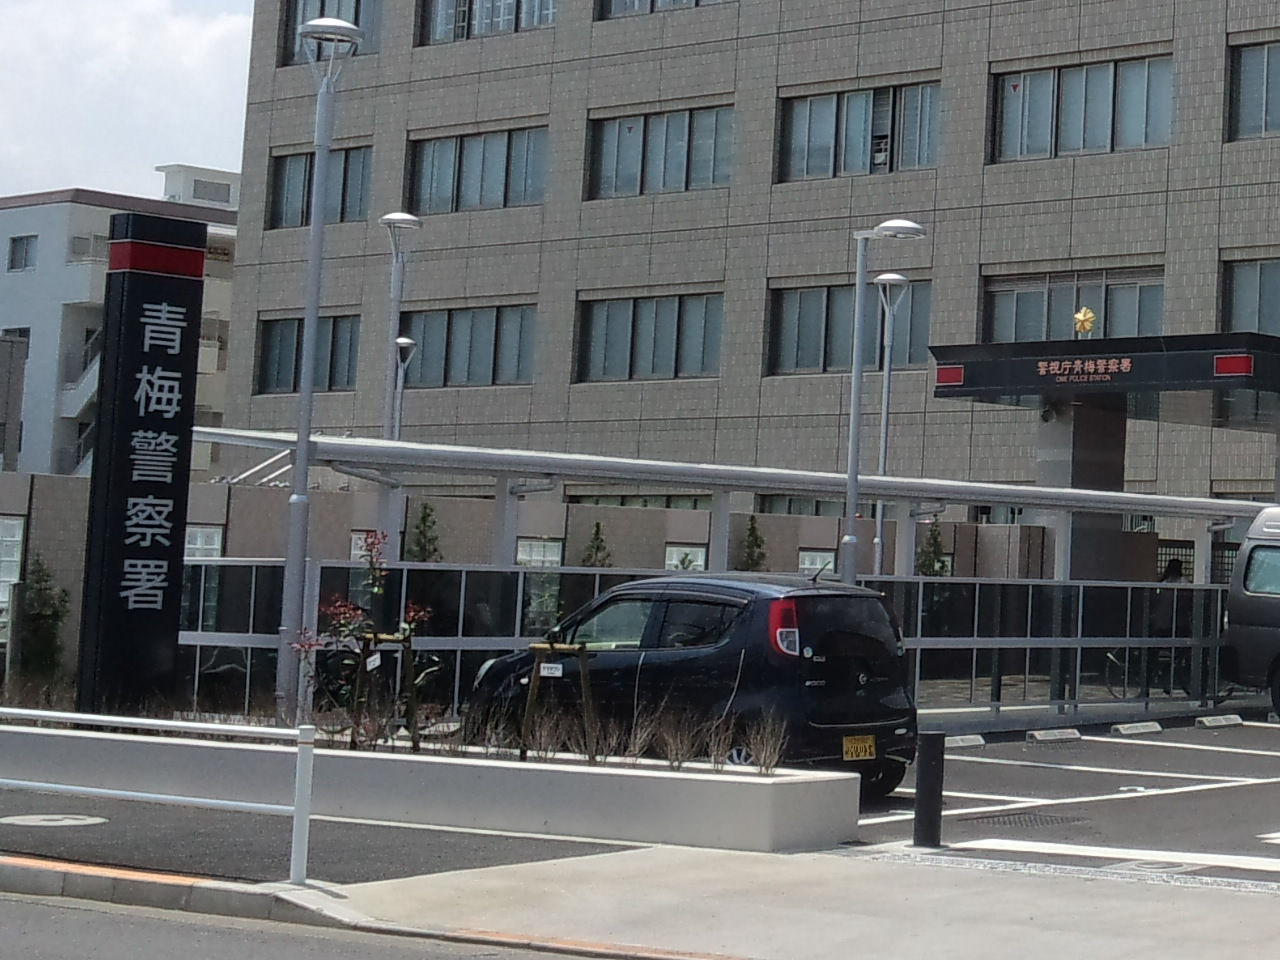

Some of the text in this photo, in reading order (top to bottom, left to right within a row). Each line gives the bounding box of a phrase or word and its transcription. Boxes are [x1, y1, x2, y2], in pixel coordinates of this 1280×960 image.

[1037, 358, 1132, 375] 警視庁青梅警察署
[119, 302, 188, 611] 青梅警察署
